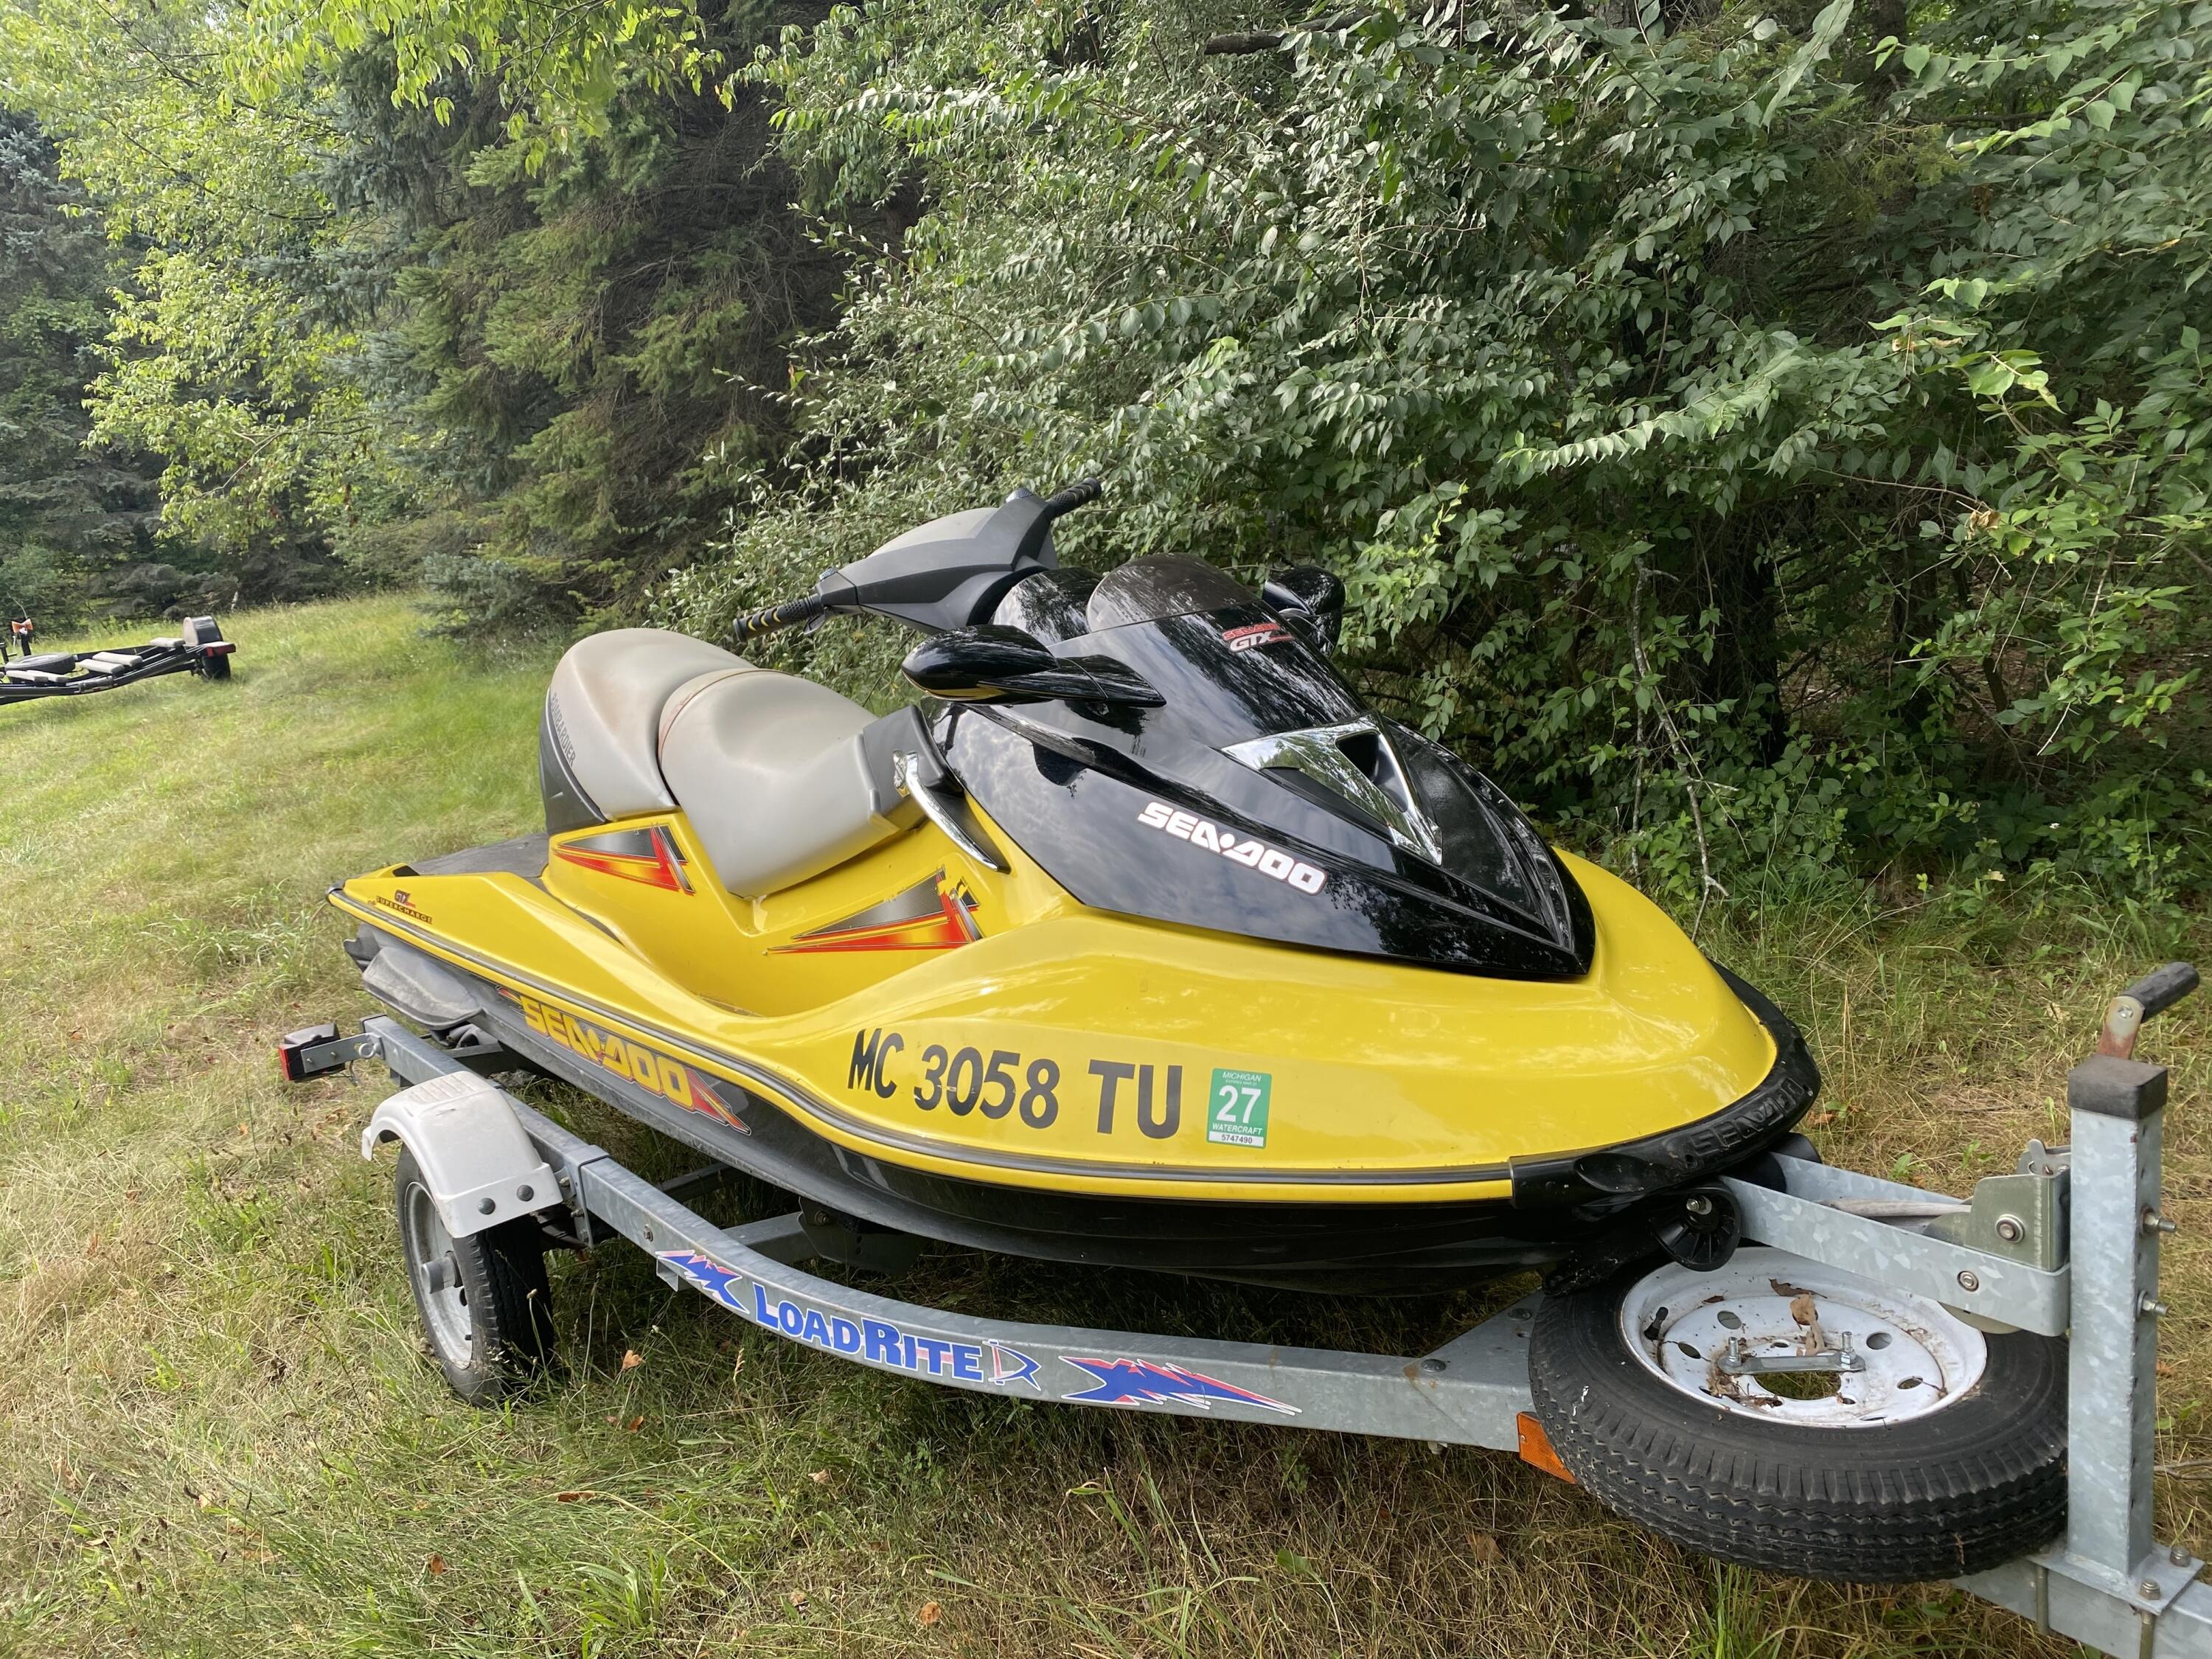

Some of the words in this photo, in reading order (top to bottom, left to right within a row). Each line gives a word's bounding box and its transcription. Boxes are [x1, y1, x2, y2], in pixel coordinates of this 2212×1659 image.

[1230, 630, 1272, 652] GTX
[551, 692, 577, 768] BOMBARDIER
[847, 1027, 905, 1099] MC
[913, 1044, 1060, 1130] 3058
[1088, 1059, 1183, 1140] TU
[1222, 1071, 1262, 1082] MICHIGAN
[1217, 1085, 1262, 1124] 27
[1212, 1123, 1262, 1135] WATERCRAFT
[1222, 1135, 1253, 1144] 5747490
